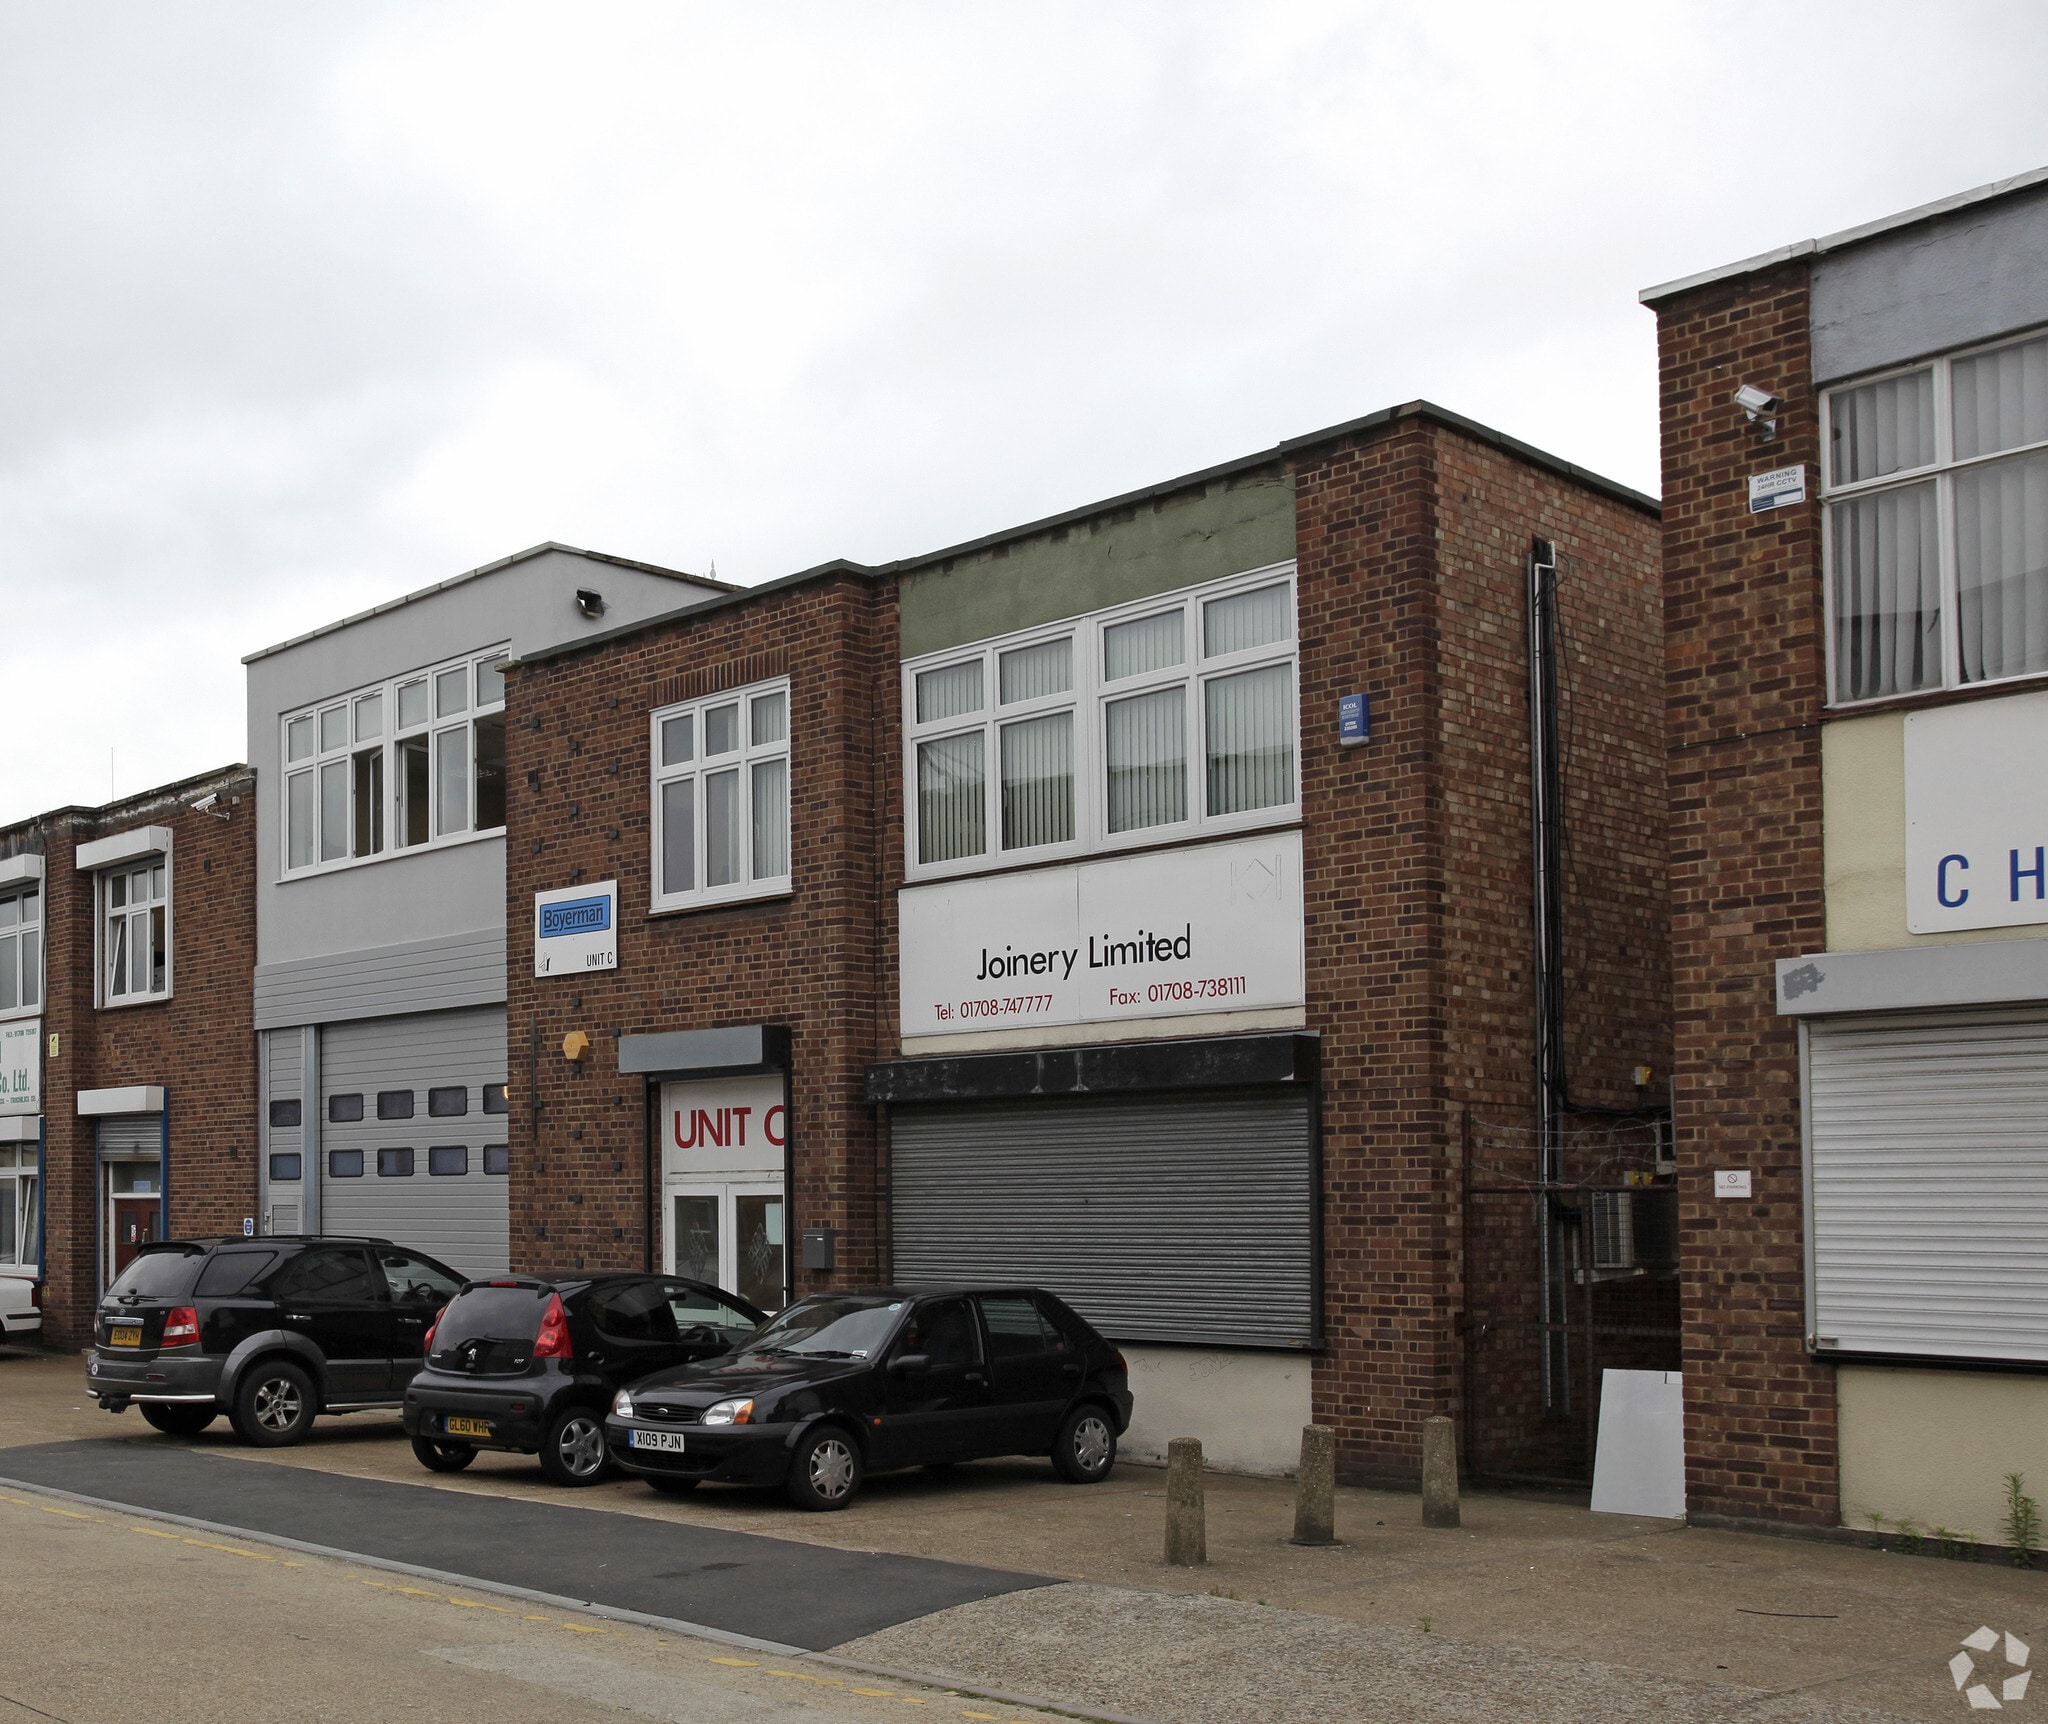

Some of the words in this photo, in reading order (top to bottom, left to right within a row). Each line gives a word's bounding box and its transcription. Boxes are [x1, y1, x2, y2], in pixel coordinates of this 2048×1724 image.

[1757, 469, 1797, 483] WARNING
[1757, 481, 1775, 491] 24HR
[1776, 476, 1797, 486] CCTV
[543, 907, 603, 931] Boyerman
[586, 953, 604, 966] UNIT
[607, 951, 613, 964] C
[976, 945, 1078, 980] Joinery
[1089, 922, 1190, 968] Limited
[1110, 988, 1141, 1005] Fax:
[1147, 976, 1246, 1003] 01708-738111
[934, 1003, 955, 1020] Tel:
[960, 994, 1053, 1018] 01708-747777
[13, 1068, 30, 1092] Ltd.
[674, 1107, 751, 1149] UNIT
[449, 1418, 471, 1433] GL60
[636, 1431, 658, 1447] X109
[660, 1433, 681, 1449] PJN
